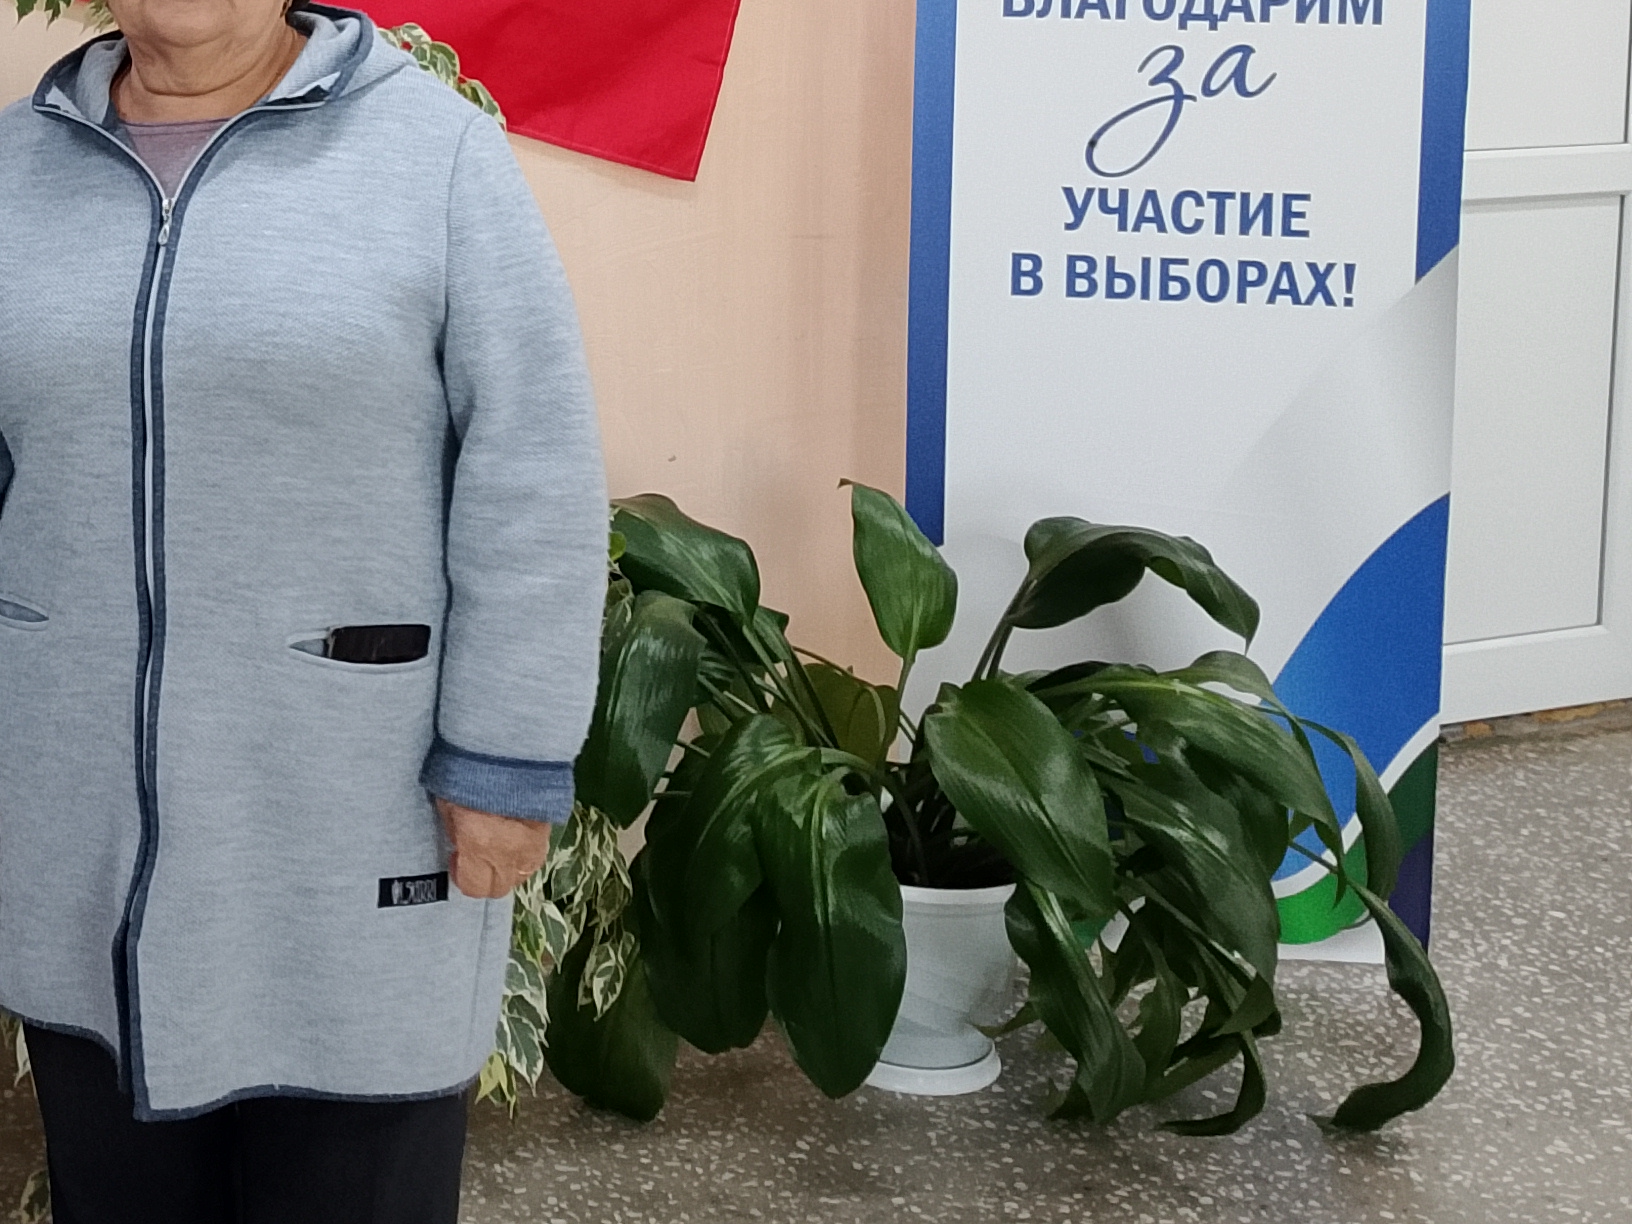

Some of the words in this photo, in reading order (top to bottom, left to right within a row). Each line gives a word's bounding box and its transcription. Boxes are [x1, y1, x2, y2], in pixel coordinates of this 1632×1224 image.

[1085, 43, 1278, 179] за
[1061, 186, 1313, 239] УЧАСТИЕ
[1009, 252, 1046, 297] В
[1065, 253, 1358, 309] ВЫБОРАХ!
